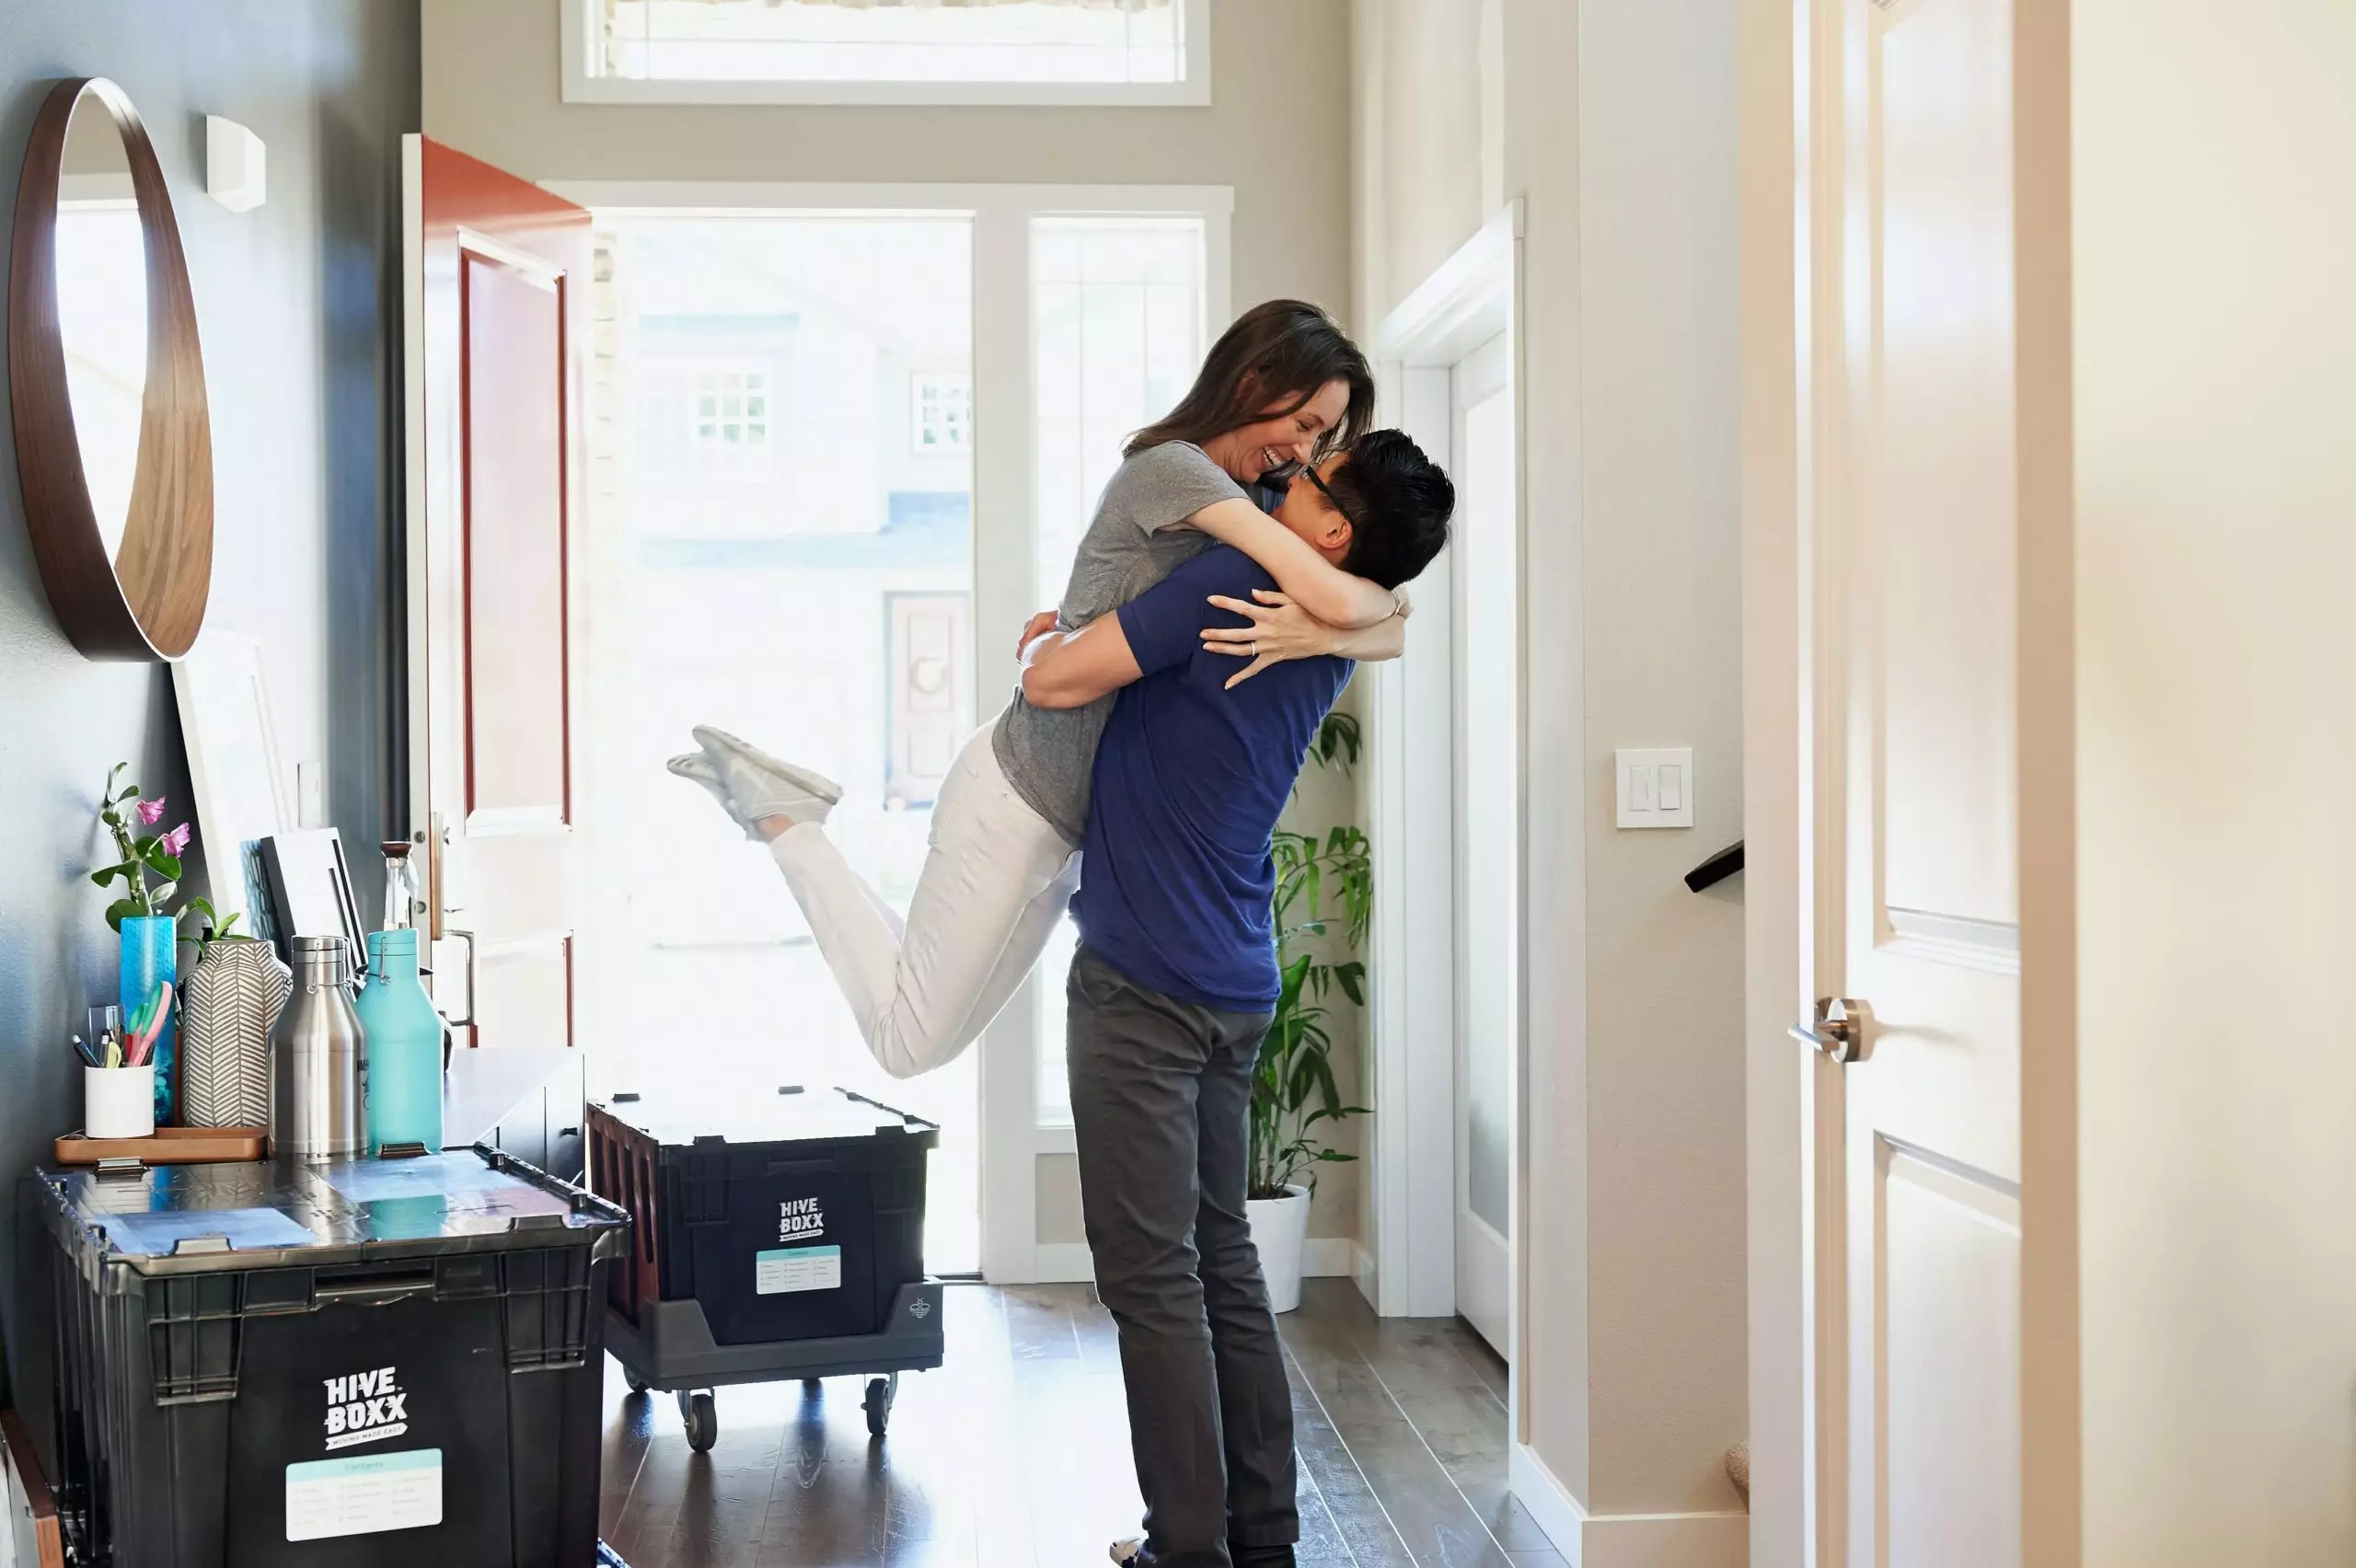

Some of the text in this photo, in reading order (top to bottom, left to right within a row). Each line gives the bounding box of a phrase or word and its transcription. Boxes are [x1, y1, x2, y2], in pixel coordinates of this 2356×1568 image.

[779, 1197, 818, 1216] HIVE
[779, 1213, 824, 1233] BOXX
[323, 1366, 396, 1405] HIVE
[324, 1393, 408, 1435] BOXX
